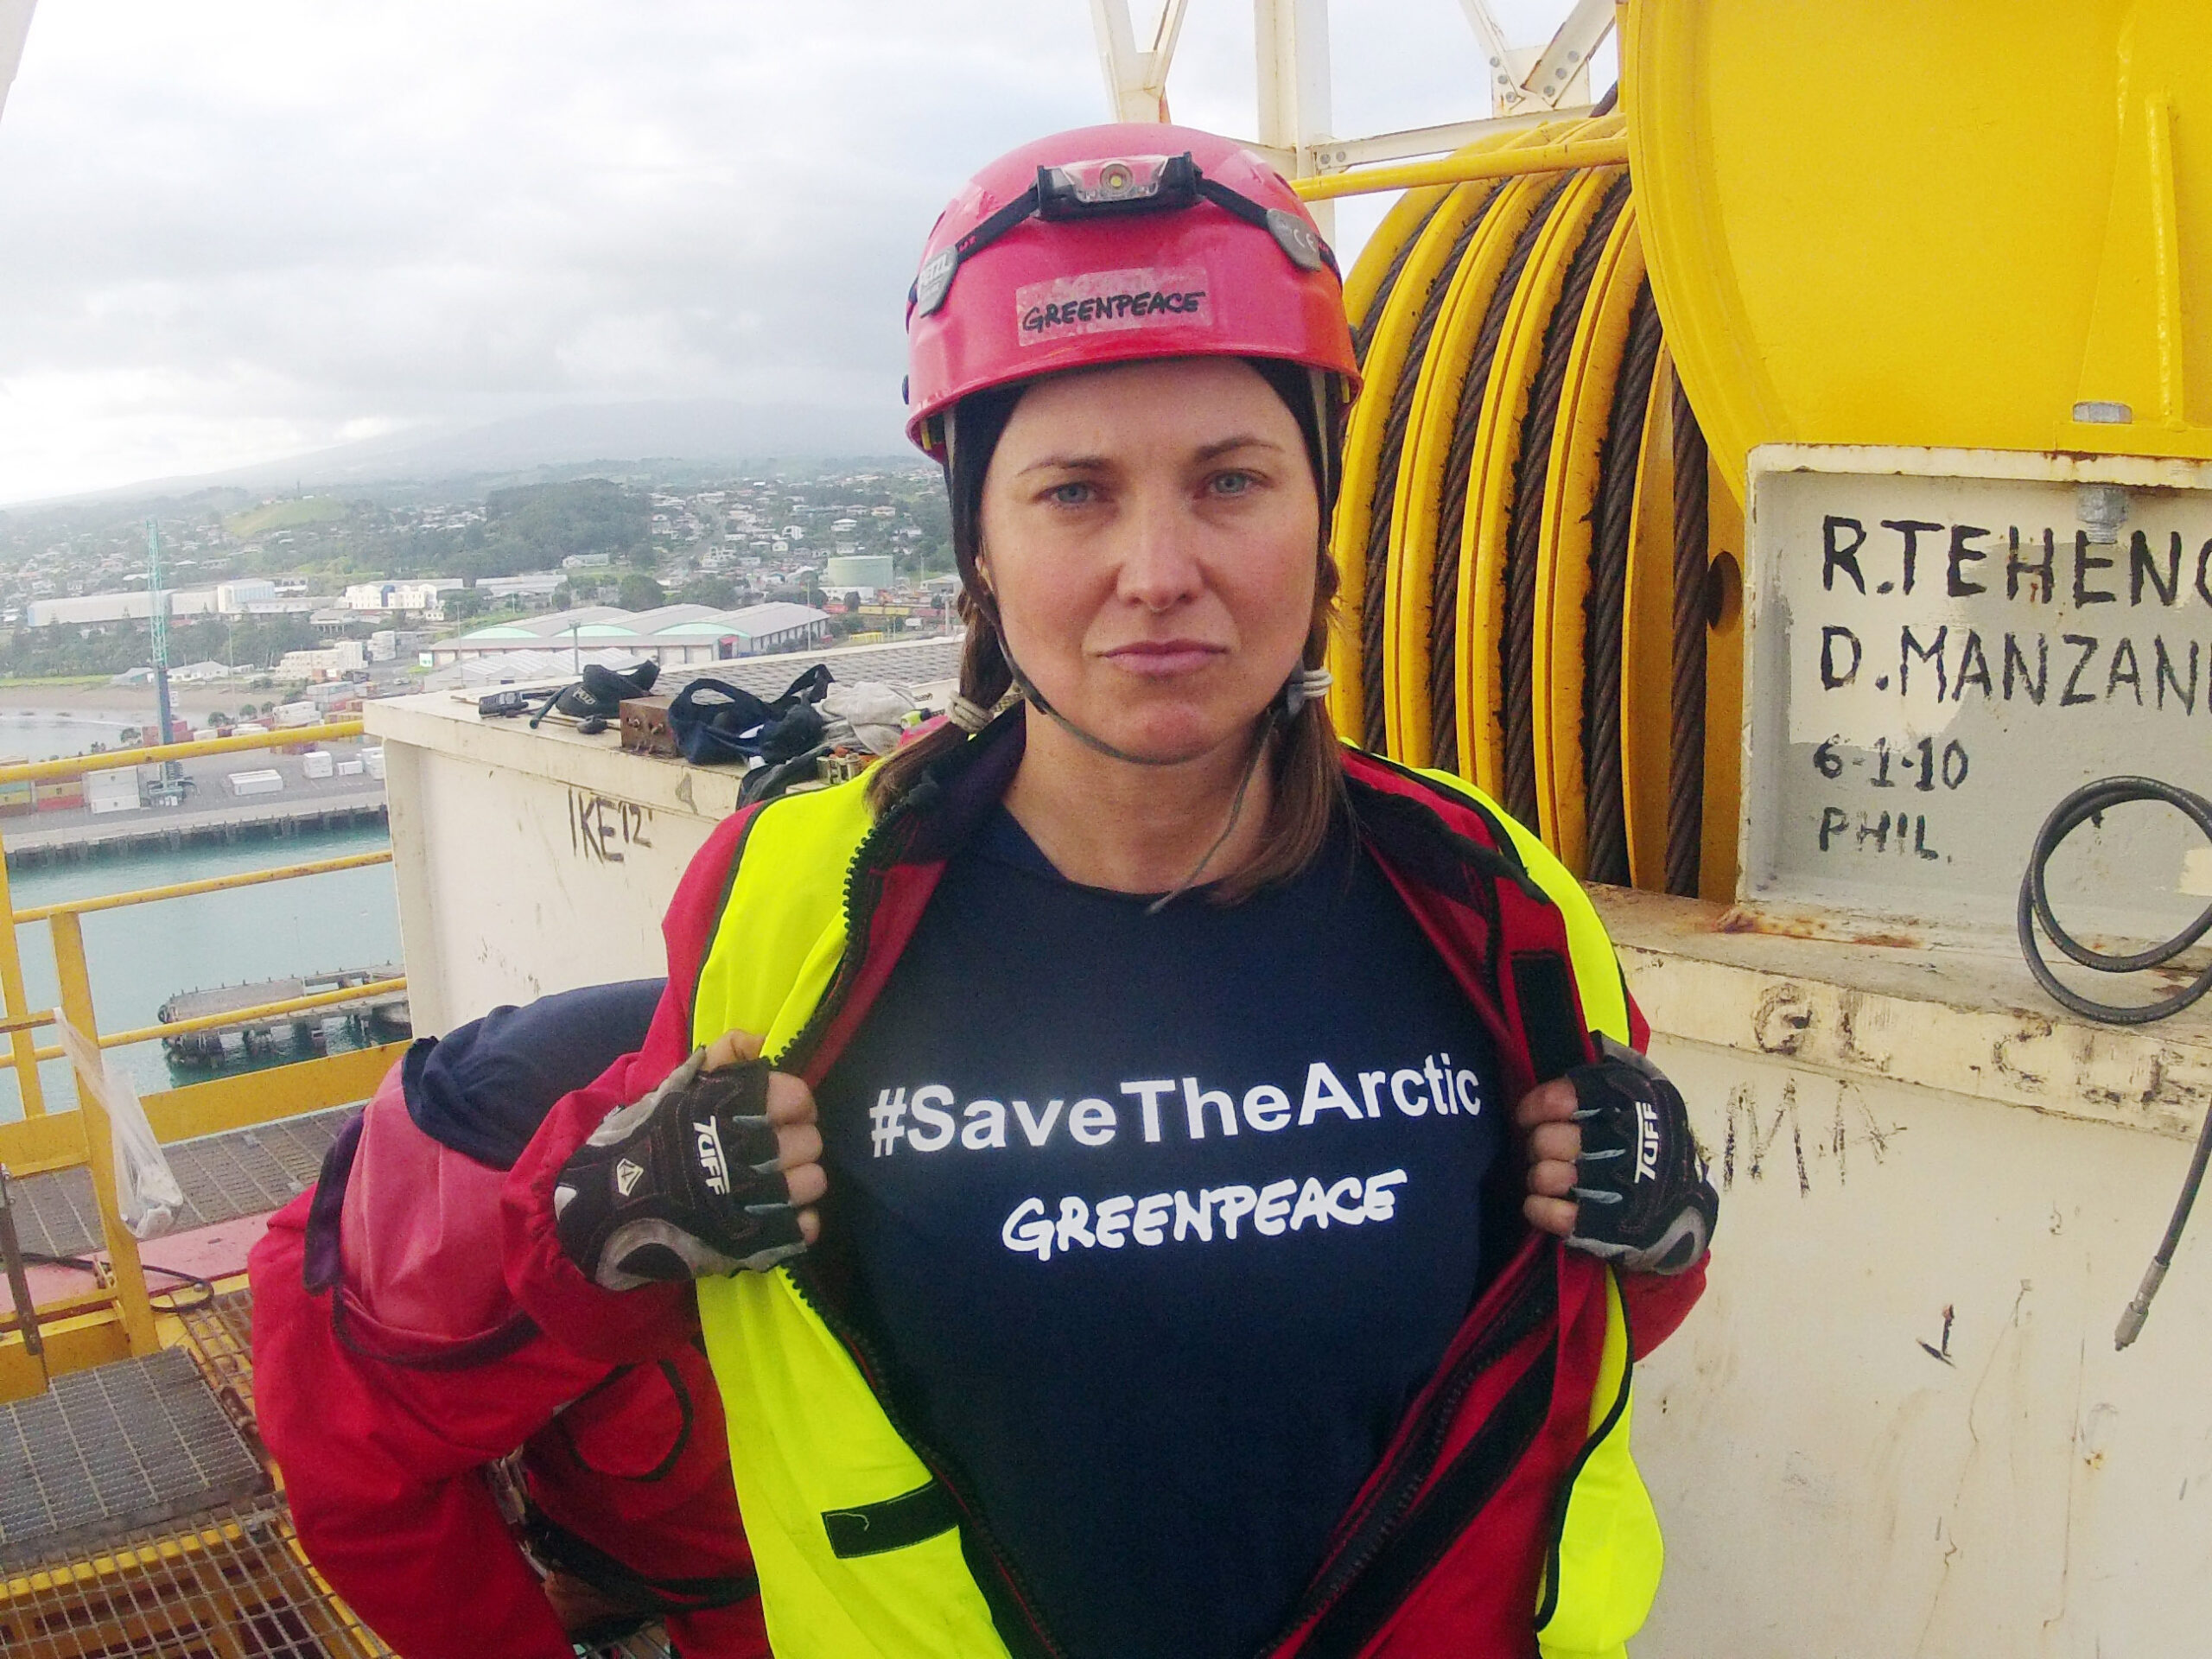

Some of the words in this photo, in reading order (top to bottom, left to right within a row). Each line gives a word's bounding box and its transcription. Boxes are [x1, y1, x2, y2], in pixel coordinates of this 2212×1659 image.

[1022, 290, 1206, 334] GREENPEACE
[1821, 624, 2212, 716] D.MANZAN
[869, 1052, 1482, 1158] #SaveTheArctic
[1633, 1101, 1659, 1185] TUFF
[693, 1115, 731, 1196] TUFF
[1001, 1168, 1408, 1262] GREENPEACE
